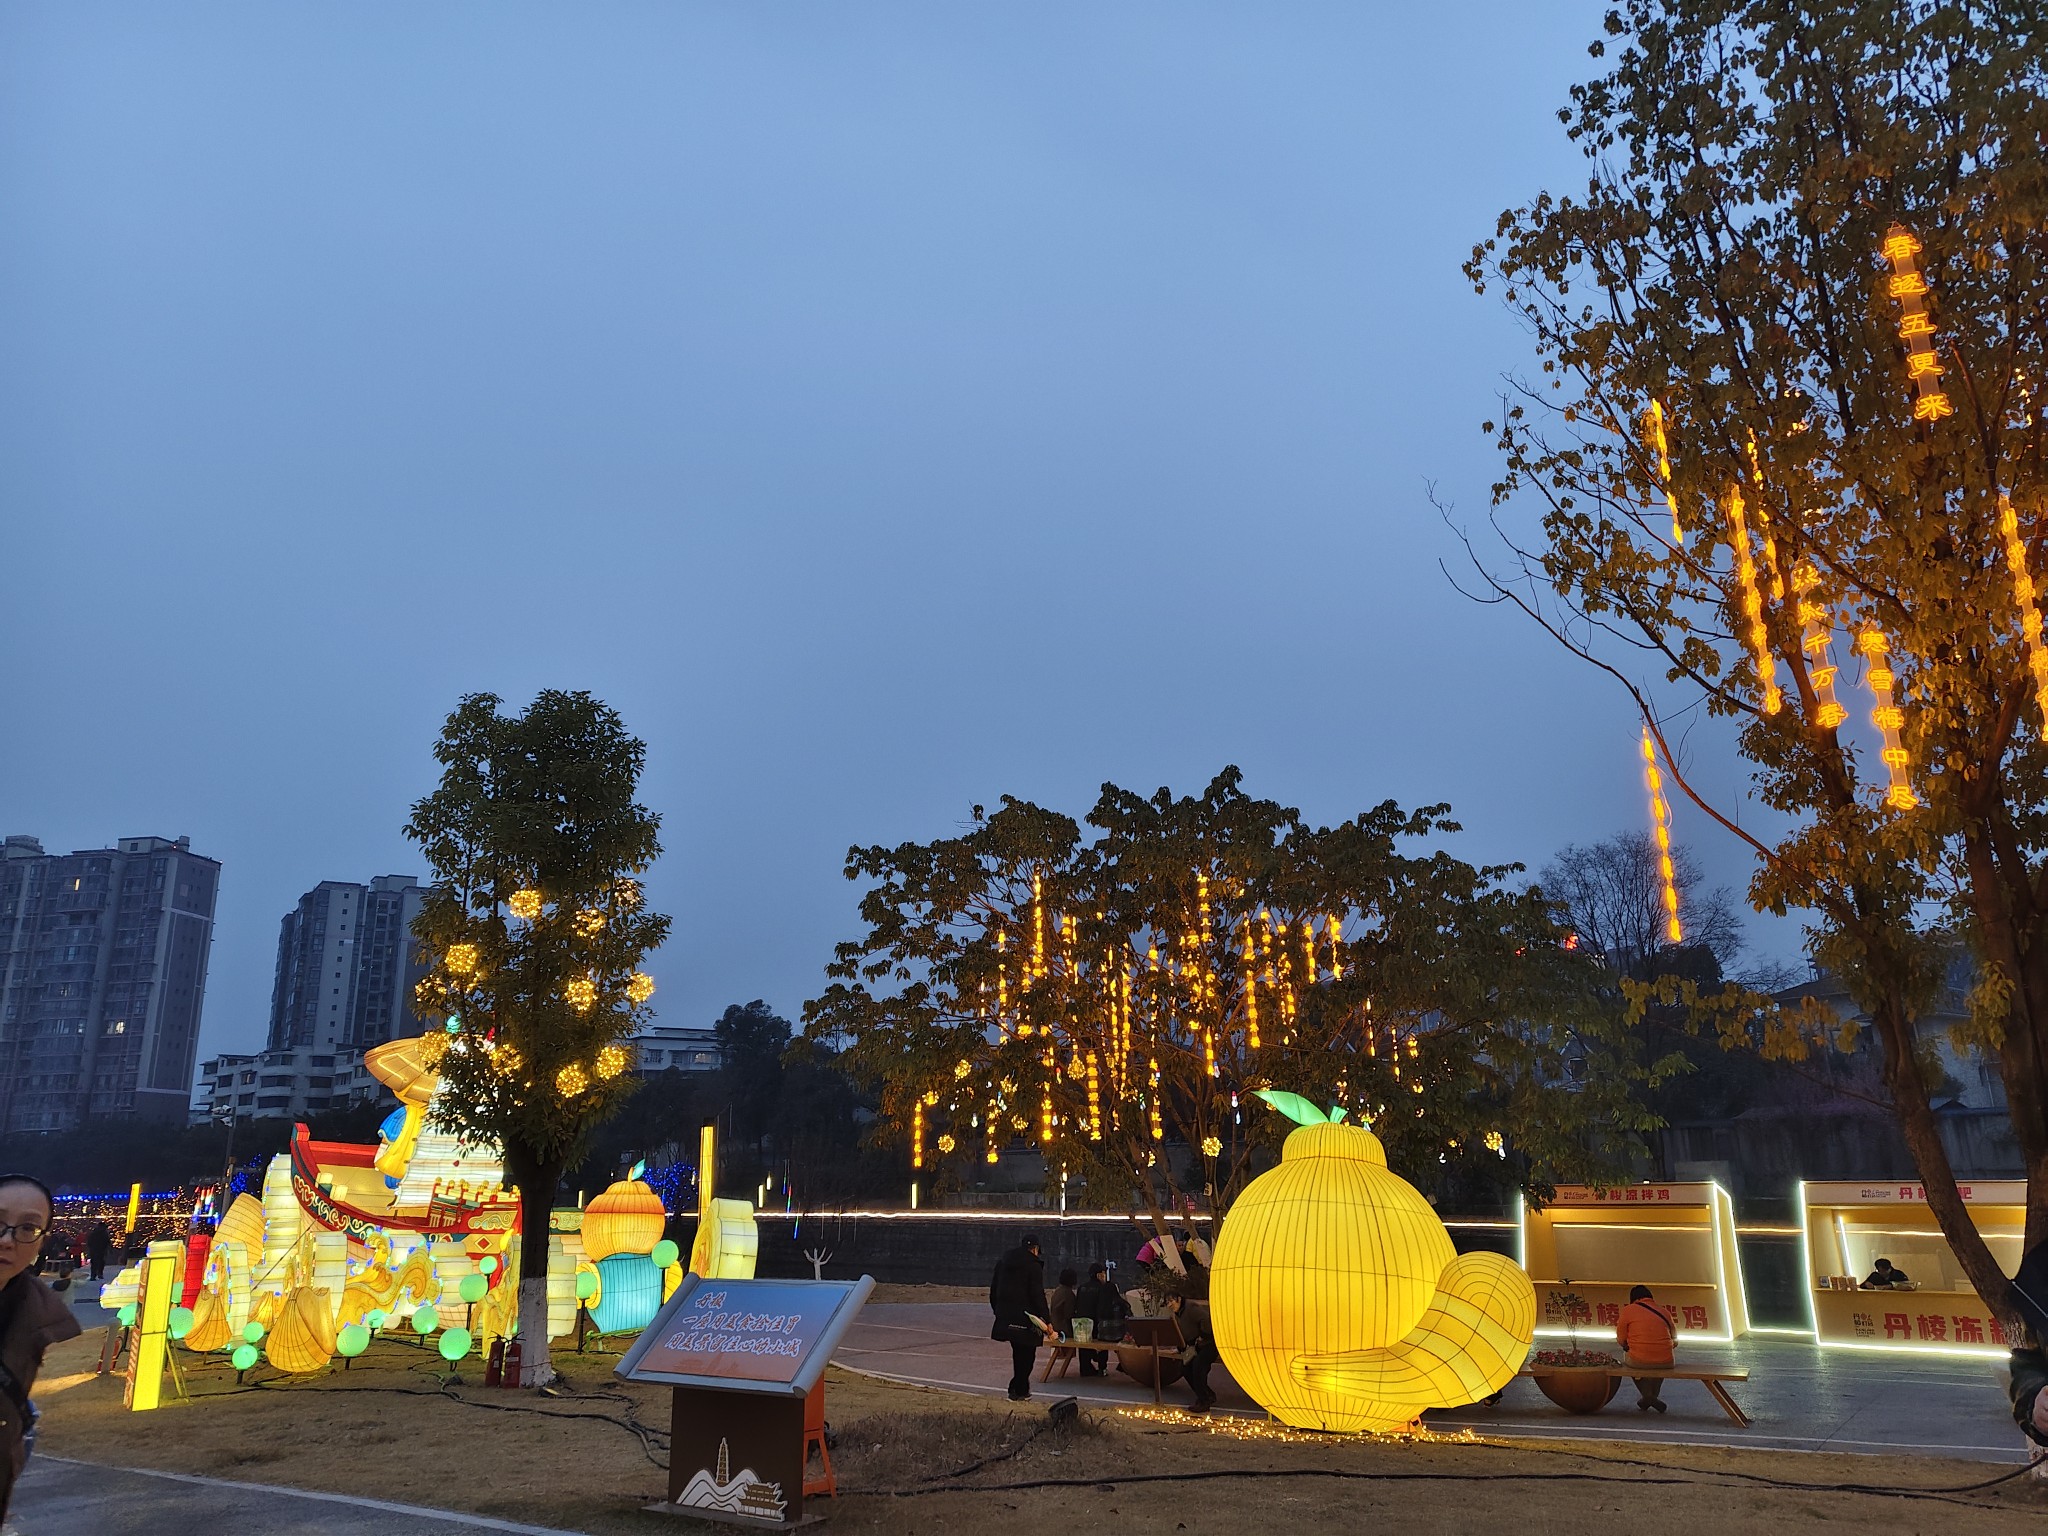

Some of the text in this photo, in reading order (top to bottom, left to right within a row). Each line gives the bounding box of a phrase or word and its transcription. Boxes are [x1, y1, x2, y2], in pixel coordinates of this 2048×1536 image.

[1881, 233, 1953, 421] 春逐五更来
[1860, 630, 1919, 811] 寒雪梅中尽
[1899, 1187, 1972, 1200] 丹棱粑
[694, 1291, 727, 1309] 丹棱
[683, 1310, 801, 1335] 一座用美食拴住胃
[1569, 1302, 1708, 1330] 丹棱鸡
[664, 1331, 802, 1357] 用美景留住心的小城
